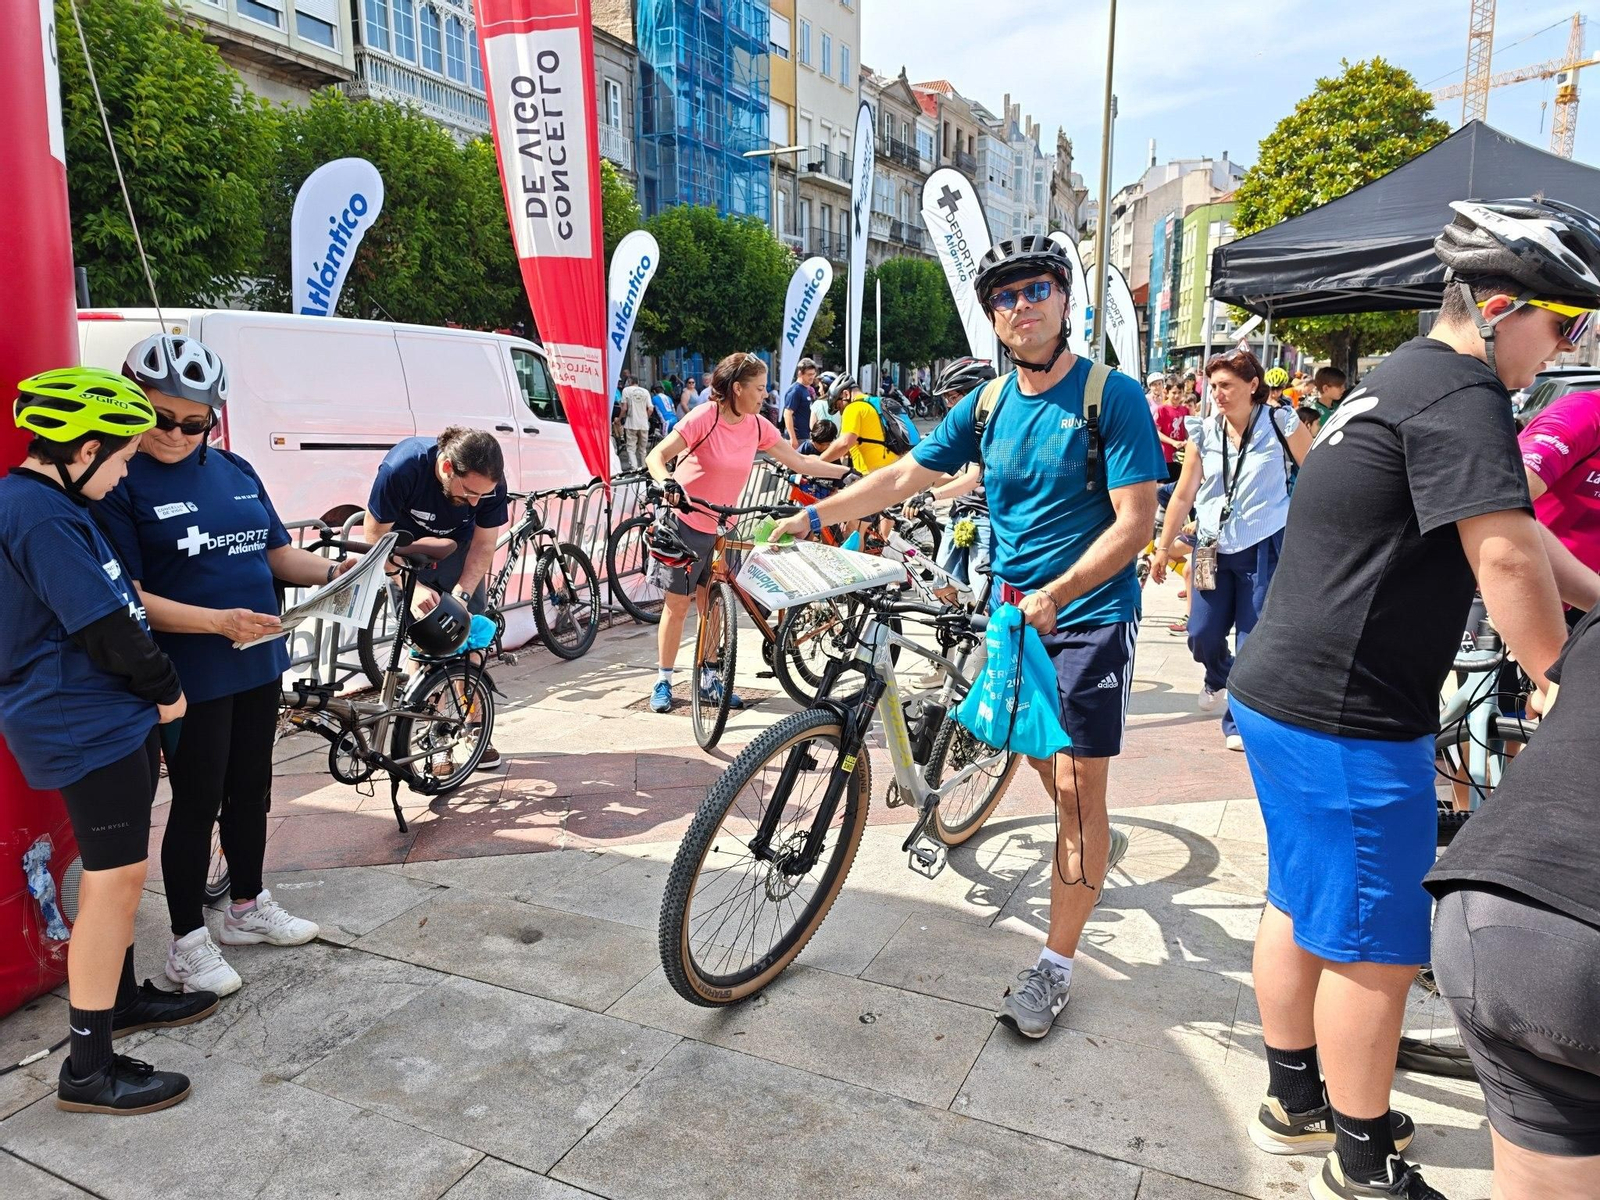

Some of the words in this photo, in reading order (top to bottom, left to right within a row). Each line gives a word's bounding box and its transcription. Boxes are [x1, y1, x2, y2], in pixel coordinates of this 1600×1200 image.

[1472, 207, 1508, 223] MET
[945, 211, 979, 280] DEPORTE
[611, 255, 651, 353] Atlántico
[786, 267, 825, 348] Atlántico
[1106, 292, 1126, 326] EPORTE
[96, 395, 129, 410] GIRO
[207, 528, 269, 551] DEPORTE
[1097, 681, 1119, 689] adidas
